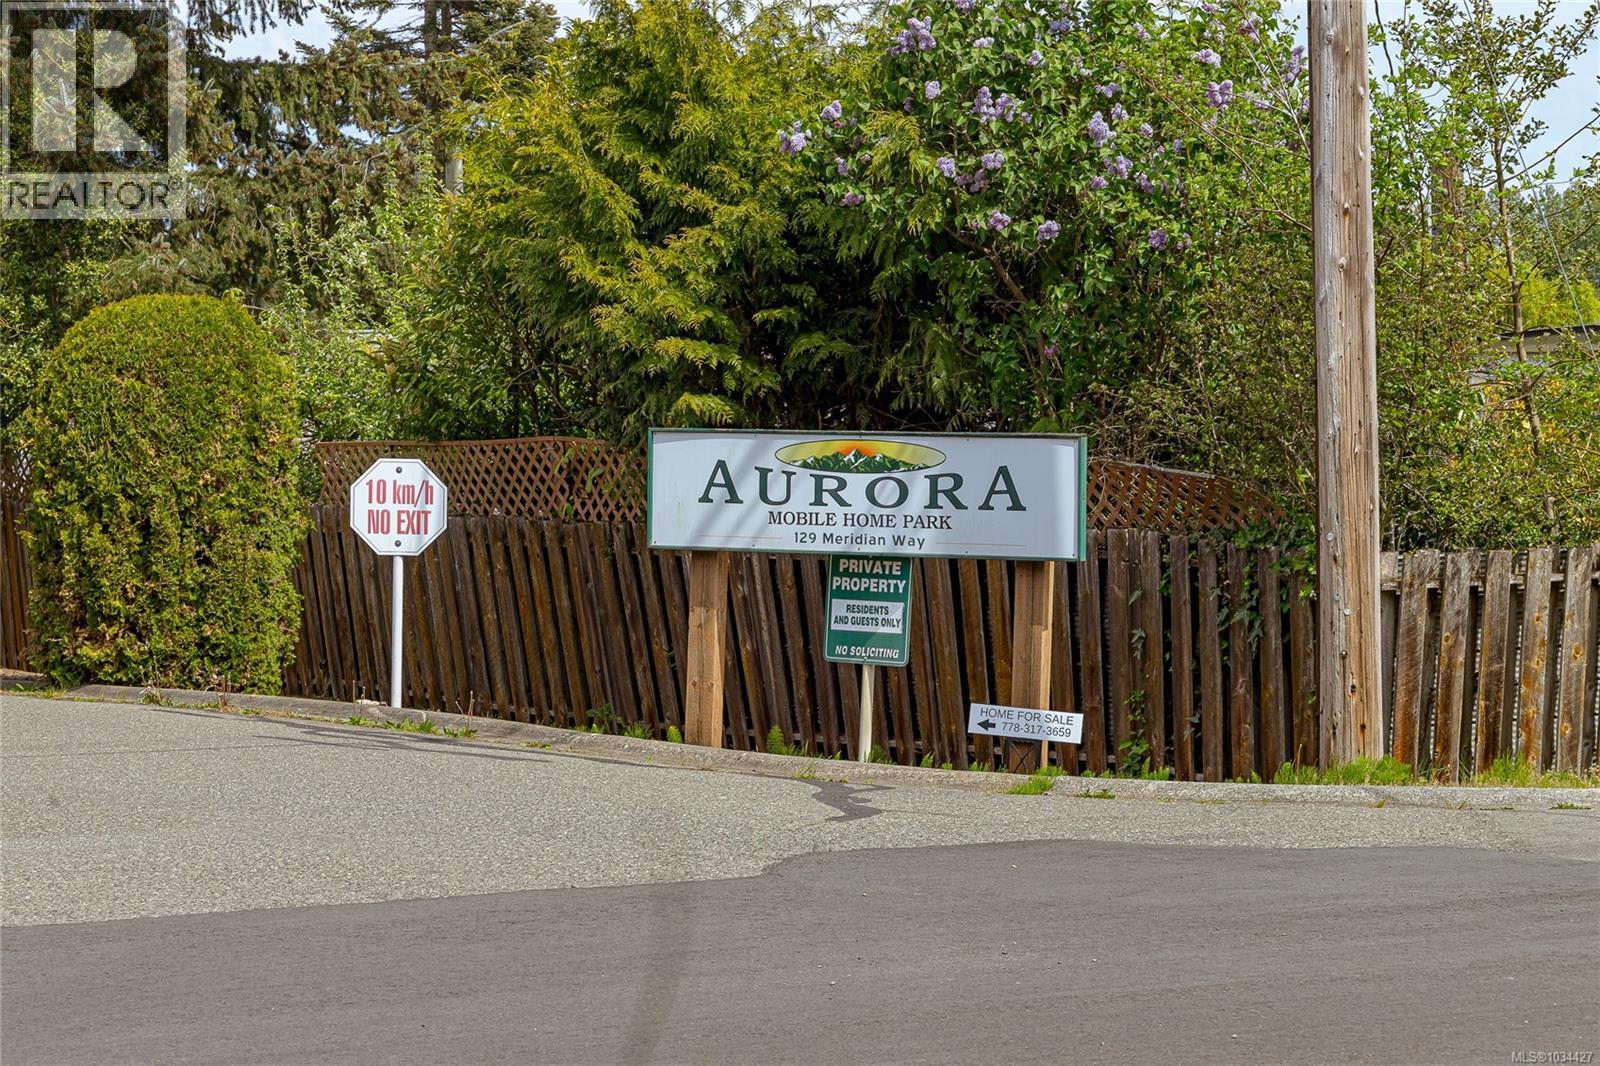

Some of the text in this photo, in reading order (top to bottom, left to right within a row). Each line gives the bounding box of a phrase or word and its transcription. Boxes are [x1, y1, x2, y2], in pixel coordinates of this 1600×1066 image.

[366, 479, 434, 508] 10 km/h
[698, 459, 1027, 511] AURORA
[367, 509, 432, 535] NO EXIT
[768, 511, 952, 530] MOBILE HOME PARK
[794, 531, 926, 550] 129 Meridian Way
[839, 558, 902, 575] PRIVATE
[832, 576, 906, 593] PROPERTY
[846, 604, 889, 615] RESIDENTS
[833, 615, 901, 628] AND GUESTS ONLY
[835, 645, 899, 659] NO SOLICITING
[980, 707, 1074, 726] HOME FOR SALE
[1001, 721, 1071, 738] 778-317-3659
